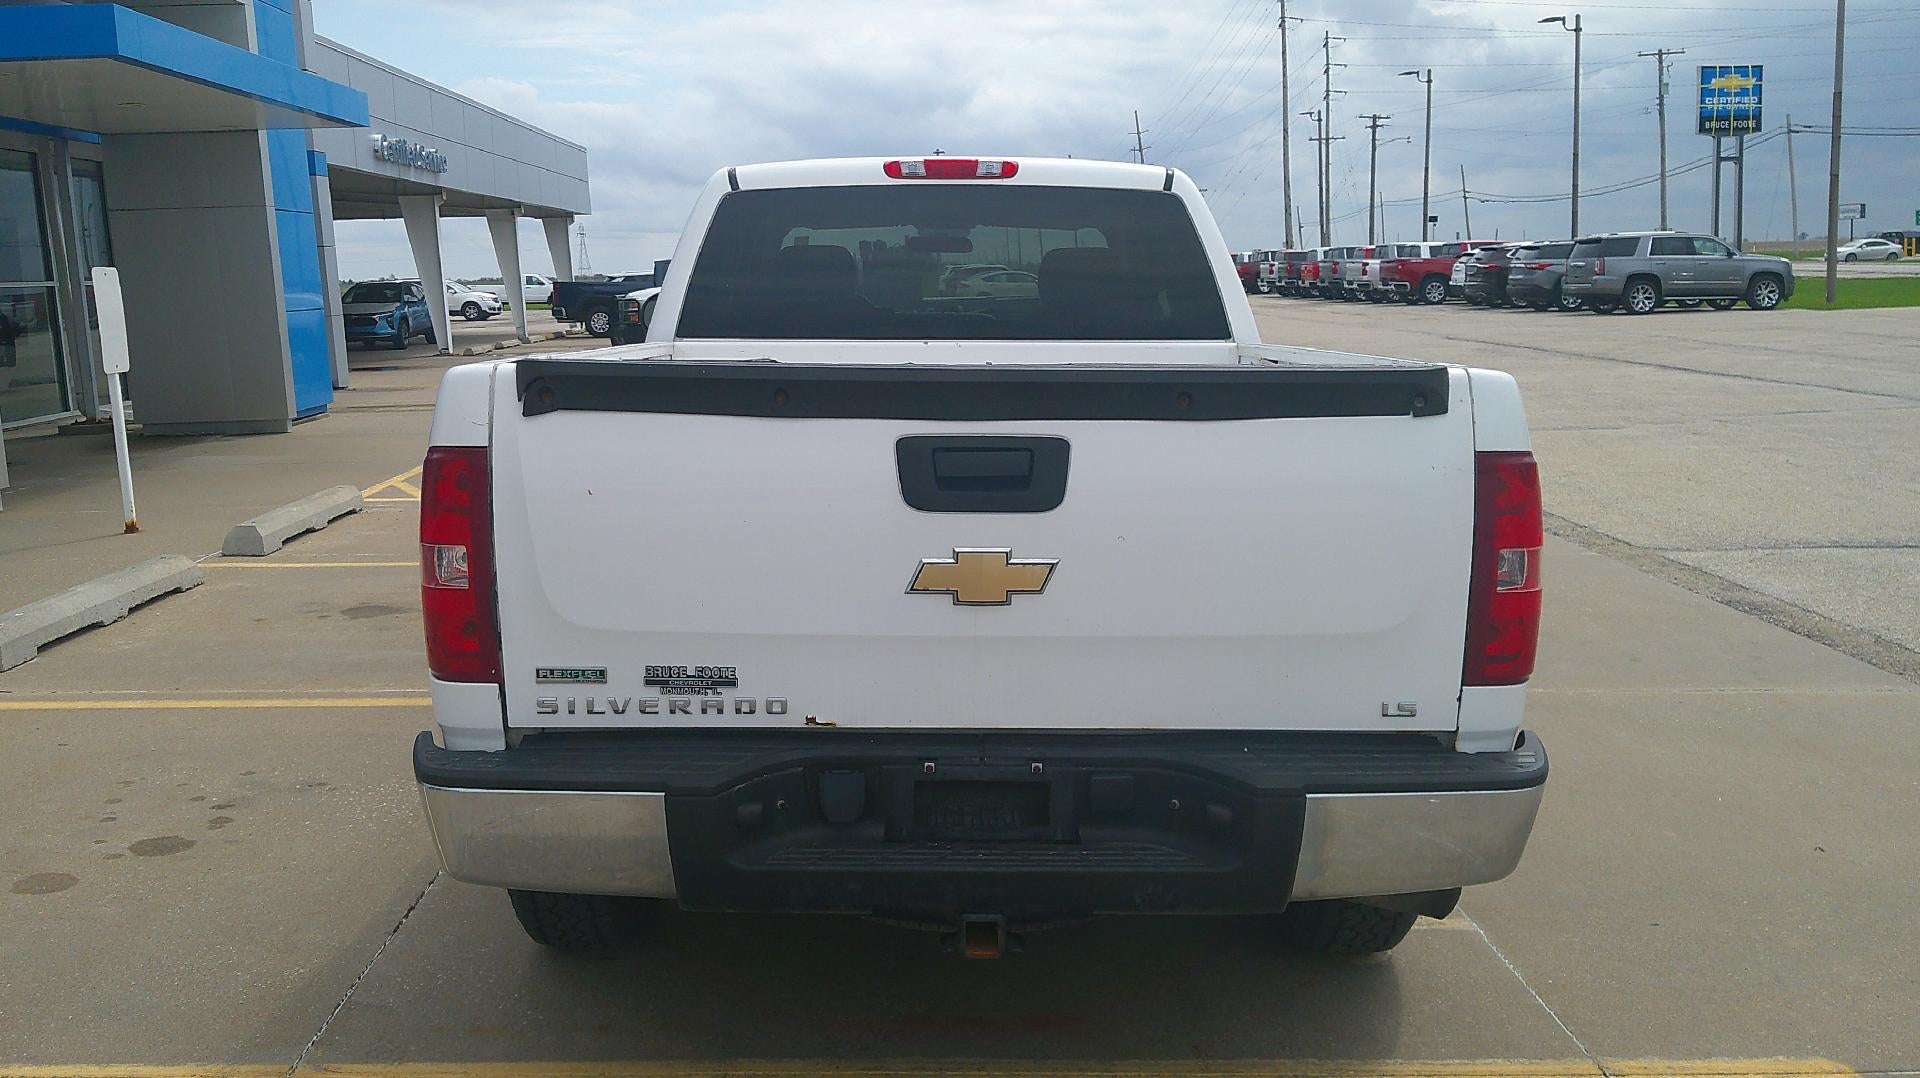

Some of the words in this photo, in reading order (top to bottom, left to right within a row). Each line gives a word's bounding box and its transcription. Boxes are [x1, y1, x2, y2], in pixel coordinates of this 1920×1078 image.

[1705, 96, 1758, 104] CERTIFIED
[1705, 121, 1730, 129] BRUCE
[1734, 120, 1757, 128] FOOTE
[539, 670, 604, 679] FLEXFUEL
[645, 665, 688, 678] BRUCE
[695, 666, 737, 679] FOOTE
[536, 697, 788, 714] SILVERADO
[1381, 701, 1417, 717] LS
